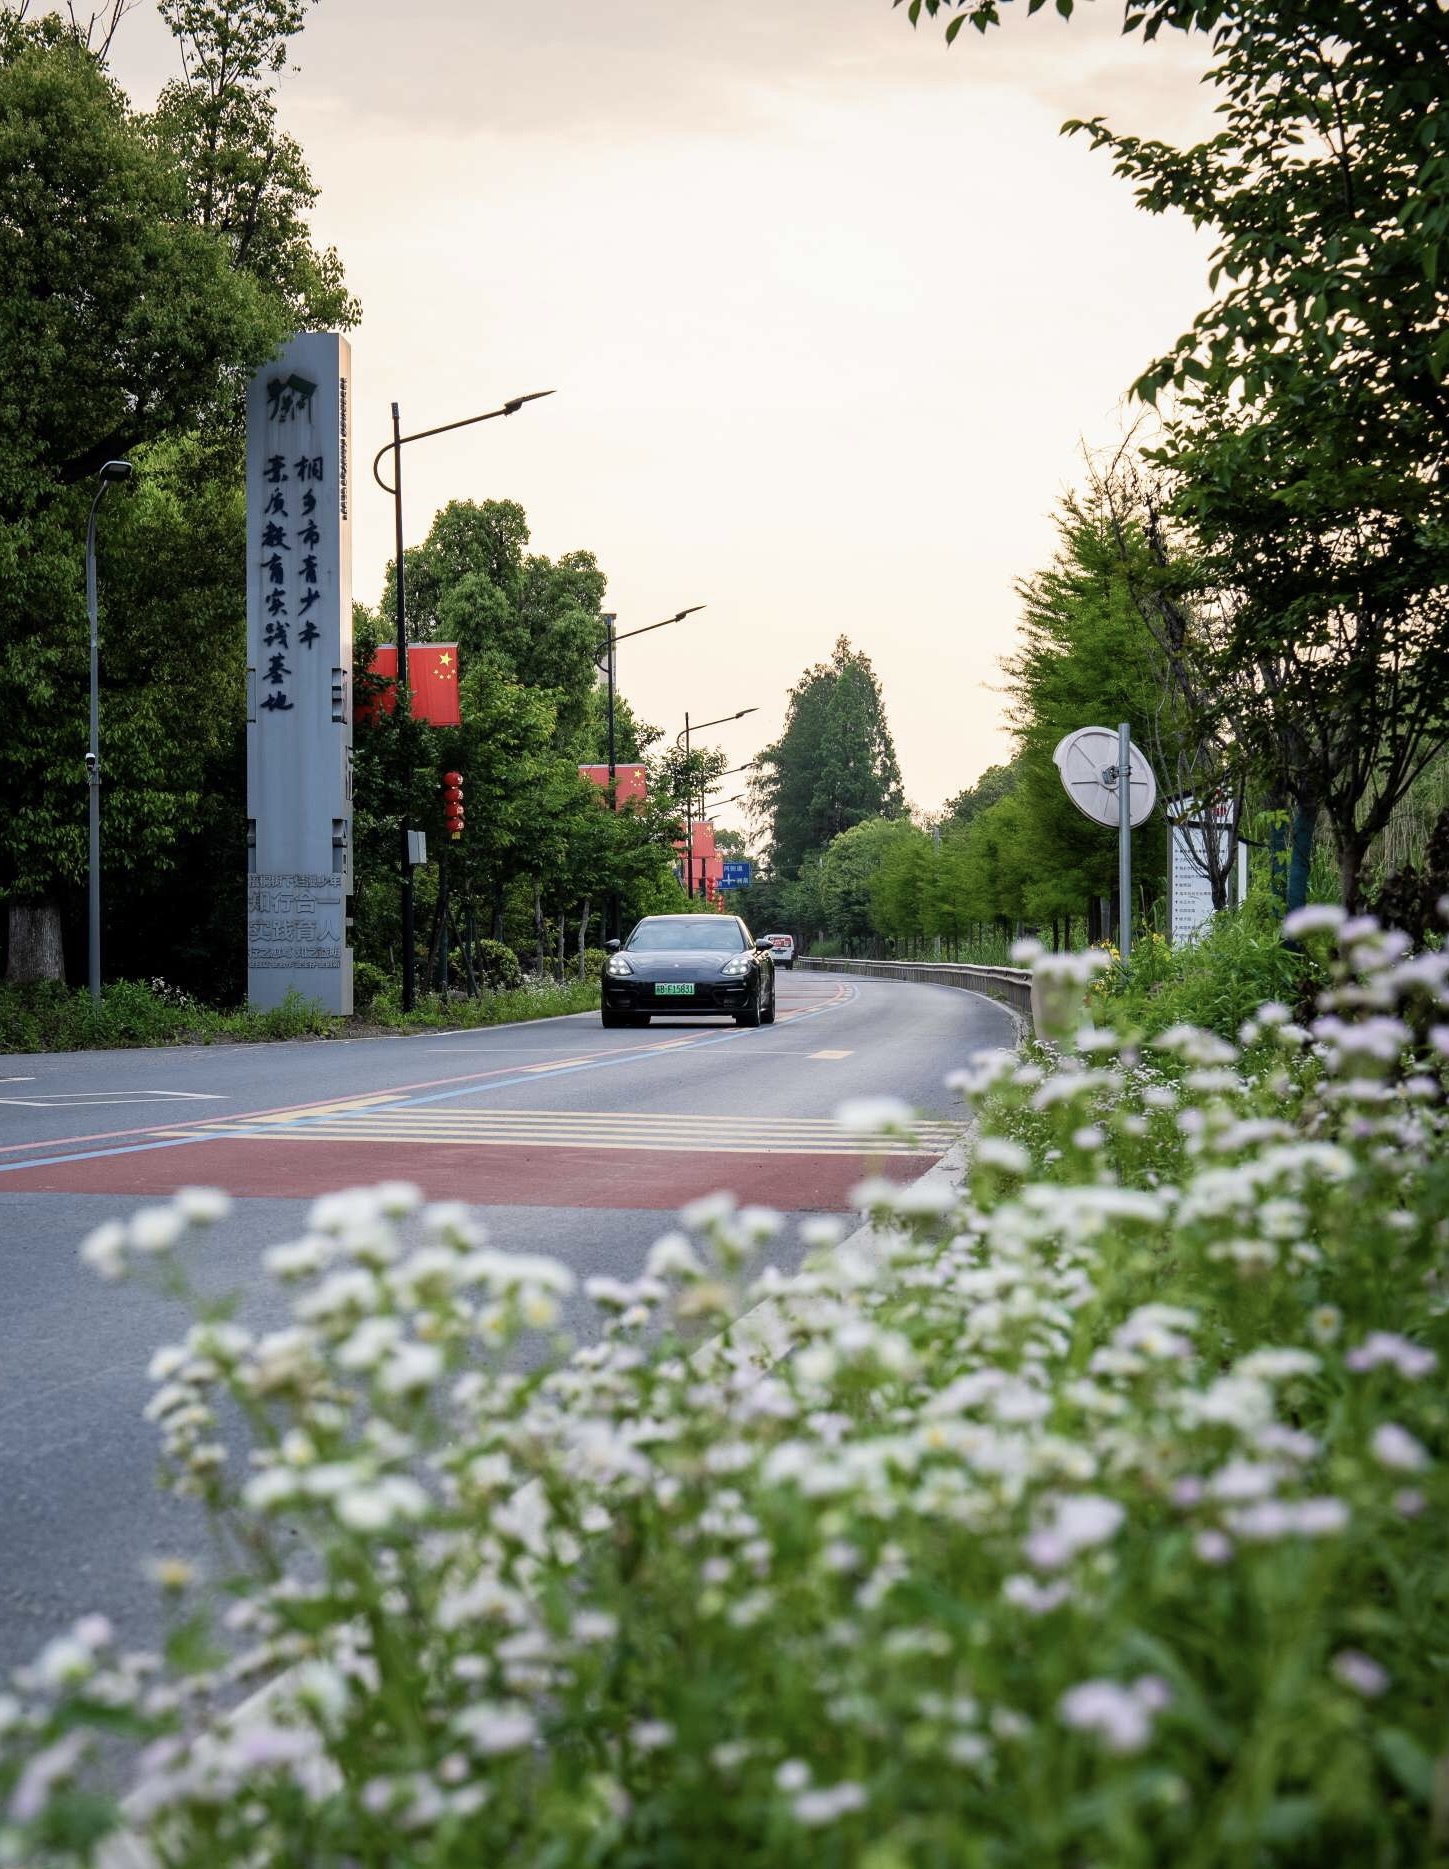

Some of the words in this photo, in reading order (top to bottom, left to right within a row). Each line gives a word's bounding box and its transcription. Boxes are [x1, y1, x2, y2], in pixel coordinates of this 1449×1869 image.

[260, 454, 294, 712] 素质教育实践基地
[293, 455, 324, 650] 桐乡市青少年
[247, 889, 341, 914] 知行合一
[247, 918, 341, 942] 实践育人
